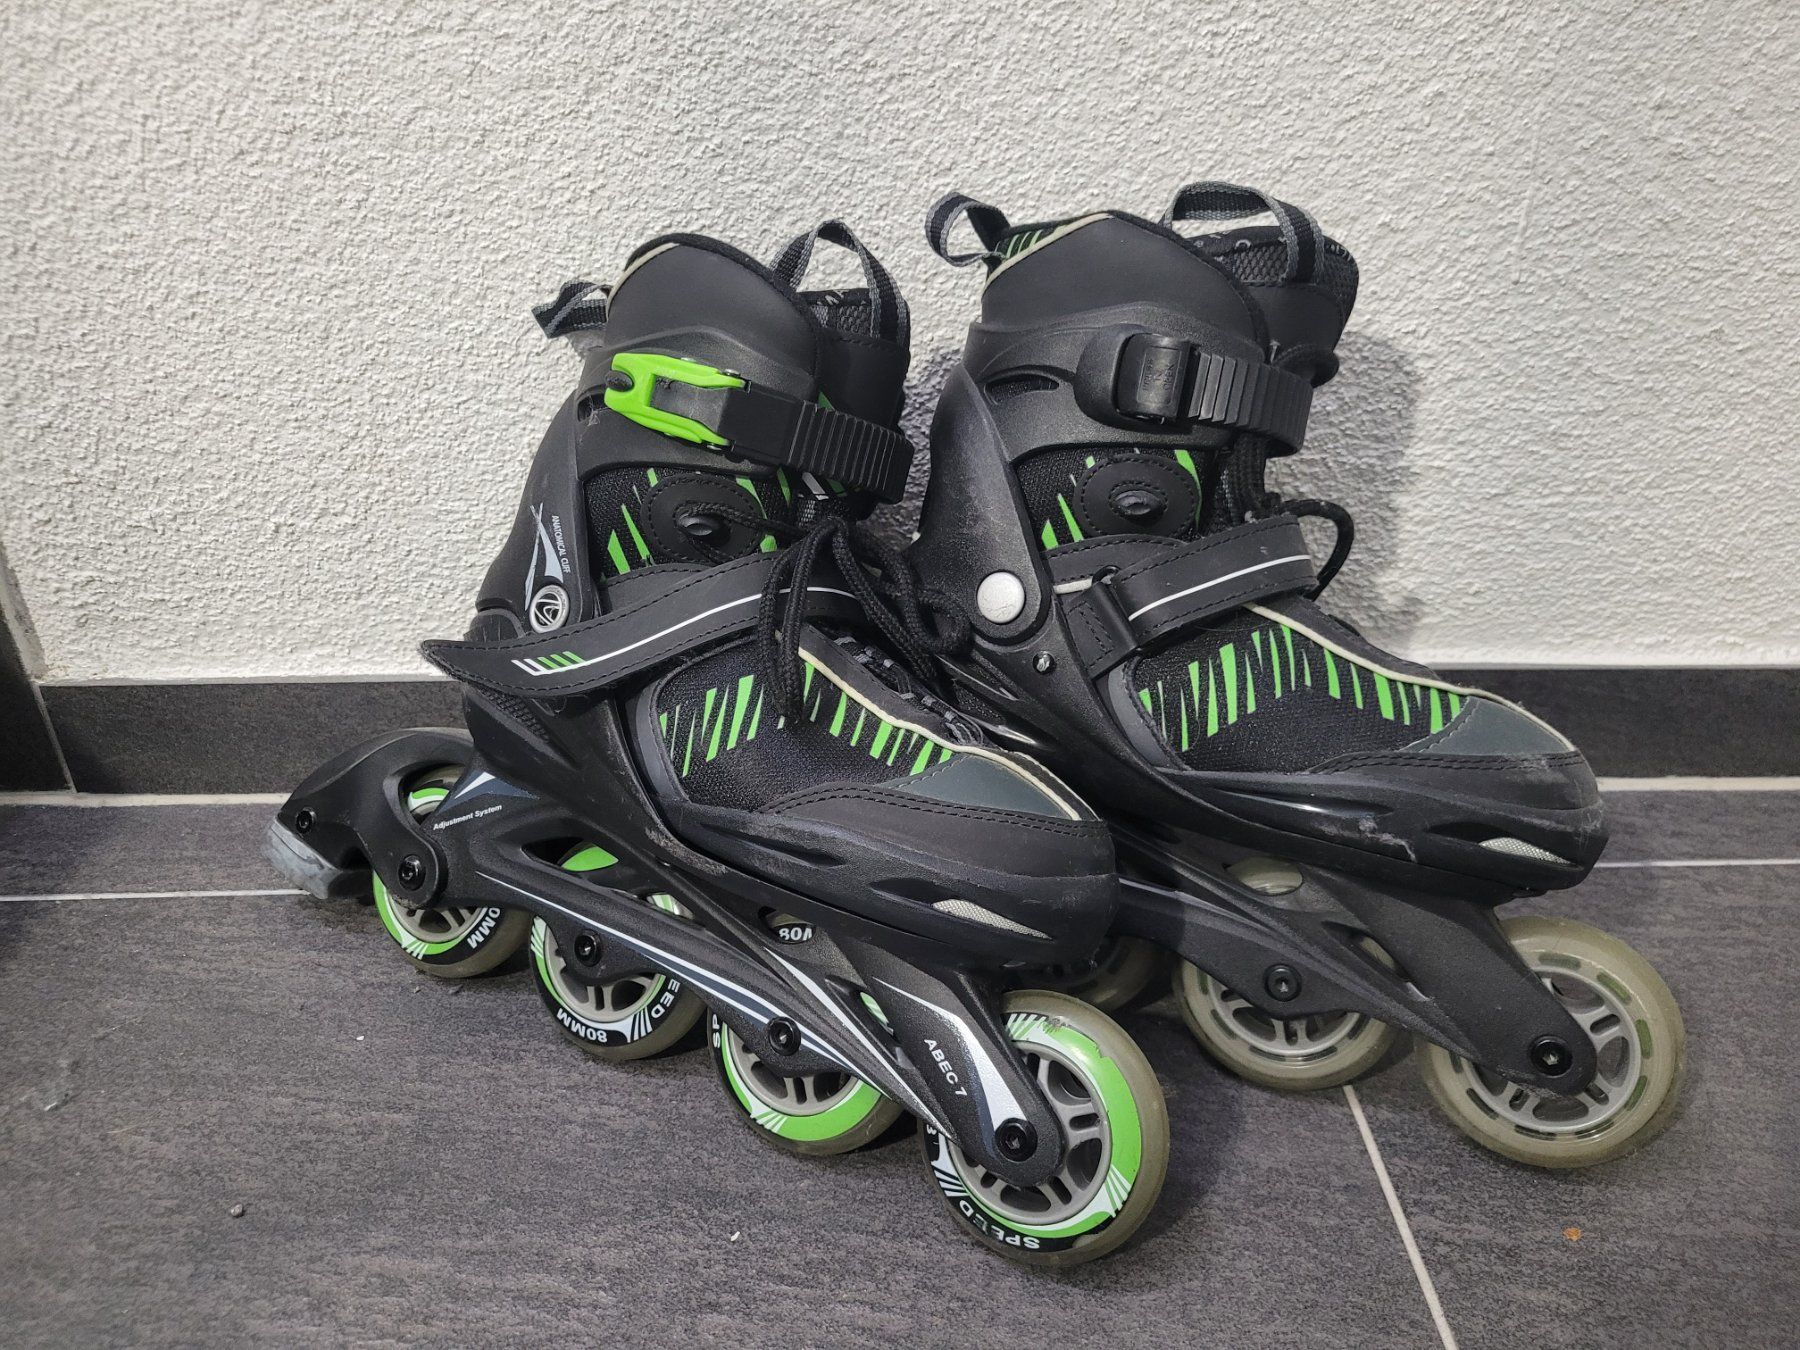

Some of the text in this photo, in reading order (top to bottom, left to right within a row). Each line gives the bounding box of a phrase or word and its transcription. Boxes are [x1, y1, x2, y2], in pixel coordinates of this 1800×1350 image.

[551, 515, 567, 556] ANATOMICAL
[560, 557, 571, 574] CUFF
[432, 804, 503, 831] Adjustment System
[466, 907, 501, 949] 0MM
[650, 978, 681, 1019] EED
[556, 1007, 608, 1043] 80MM
[923, 1039, 968, 1097] ABEC 7
[959, 1199, 1040, 1250] SPEED
